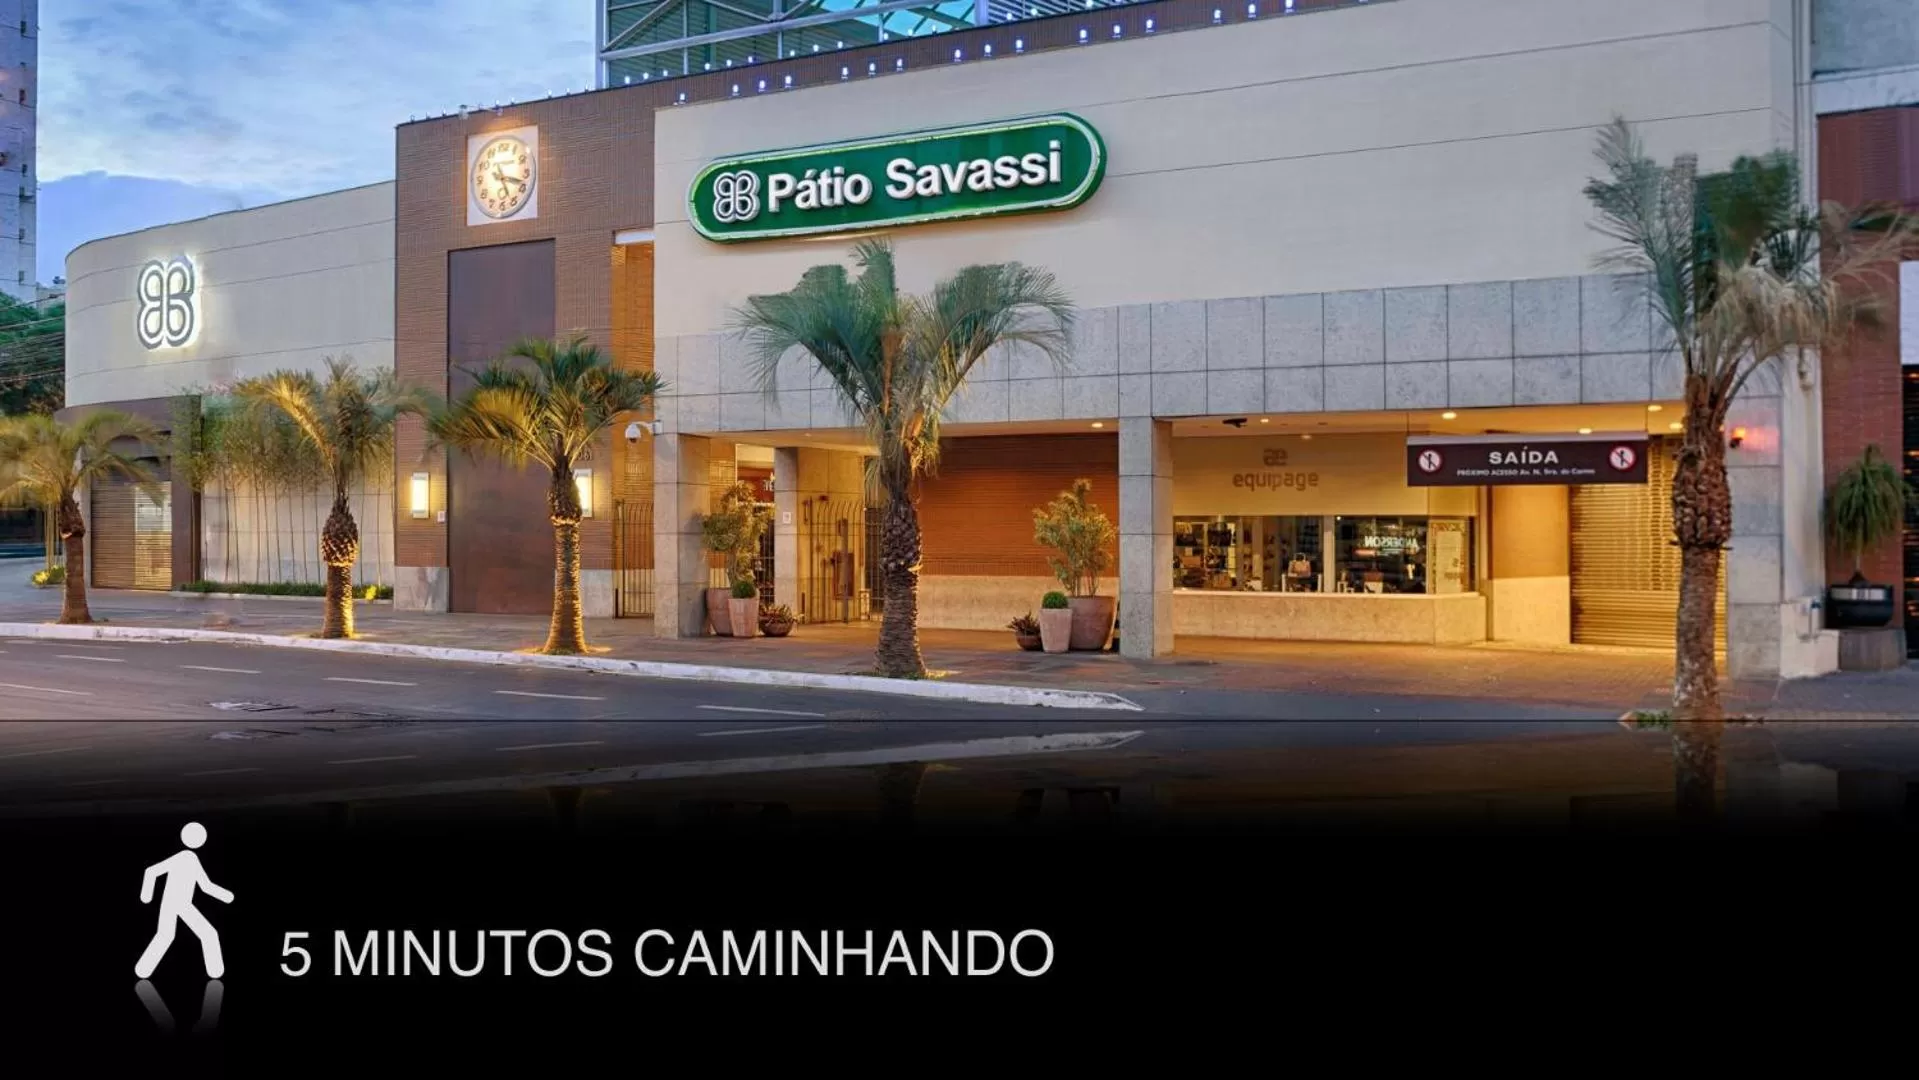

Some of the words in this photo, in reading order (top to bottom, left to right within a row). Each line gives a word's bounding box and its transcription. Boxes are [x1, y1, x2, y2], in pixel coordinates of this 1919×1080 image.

[767, 166, 872, 213] Pátio
[884, 140, 1062, 200] Savassi
[1488, 446, 1559, 465] SAÍDA
[1232, 472, 1319, 492] equipage
